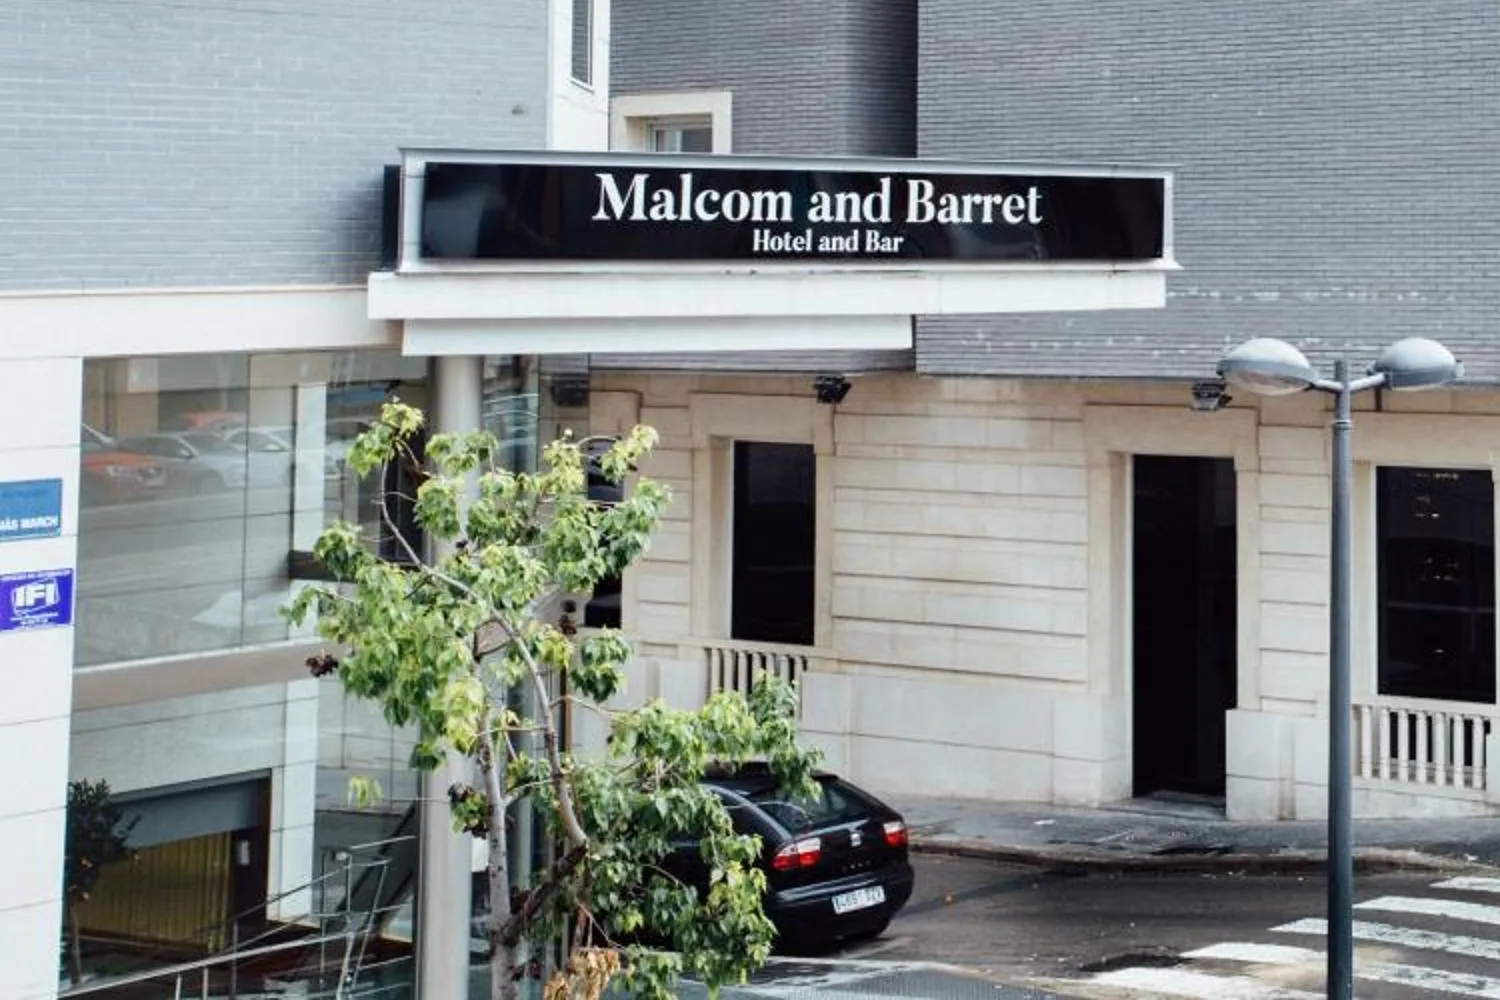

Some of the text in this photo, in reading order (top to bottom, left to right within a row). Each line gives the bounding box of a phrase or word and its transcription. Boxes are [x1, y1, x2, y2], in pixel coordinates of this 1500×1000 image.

[592, 172, 1043, 224] Malcom and Barret
[752, 228, 904, 253] Hotel and Bar
[15, 583, 55, 607] IFI
